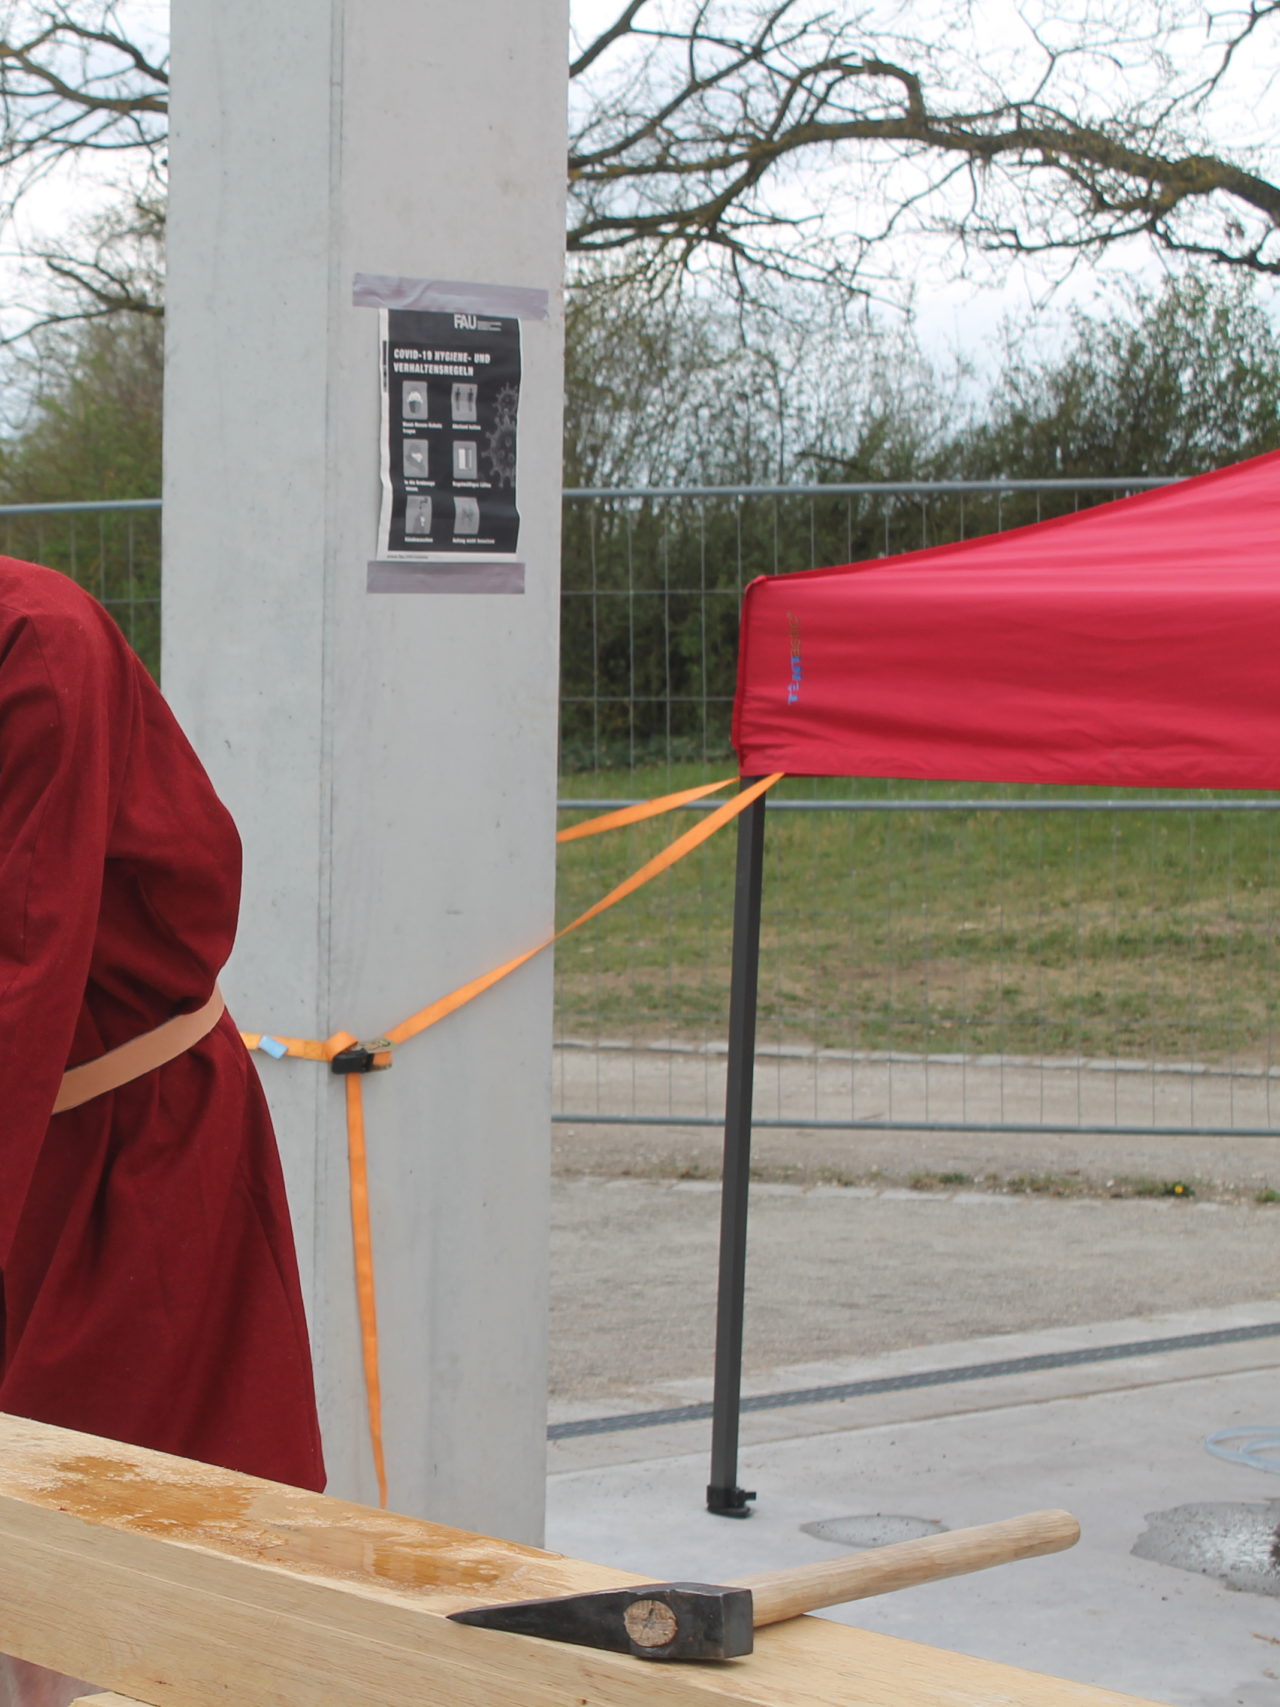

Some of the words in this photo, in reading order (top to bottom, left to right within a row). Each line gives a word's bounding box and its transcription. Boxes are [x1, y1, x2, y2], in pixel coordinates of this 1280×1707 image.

[453, 313, 477, 330] FAU
[393, 348, 433, 361] COVID-19
[434, 350, 472, 363] HYGIENE-
[474, 353, 491, 364] UND
[393, 362, 474, 376] VERHALTENSREGELN
